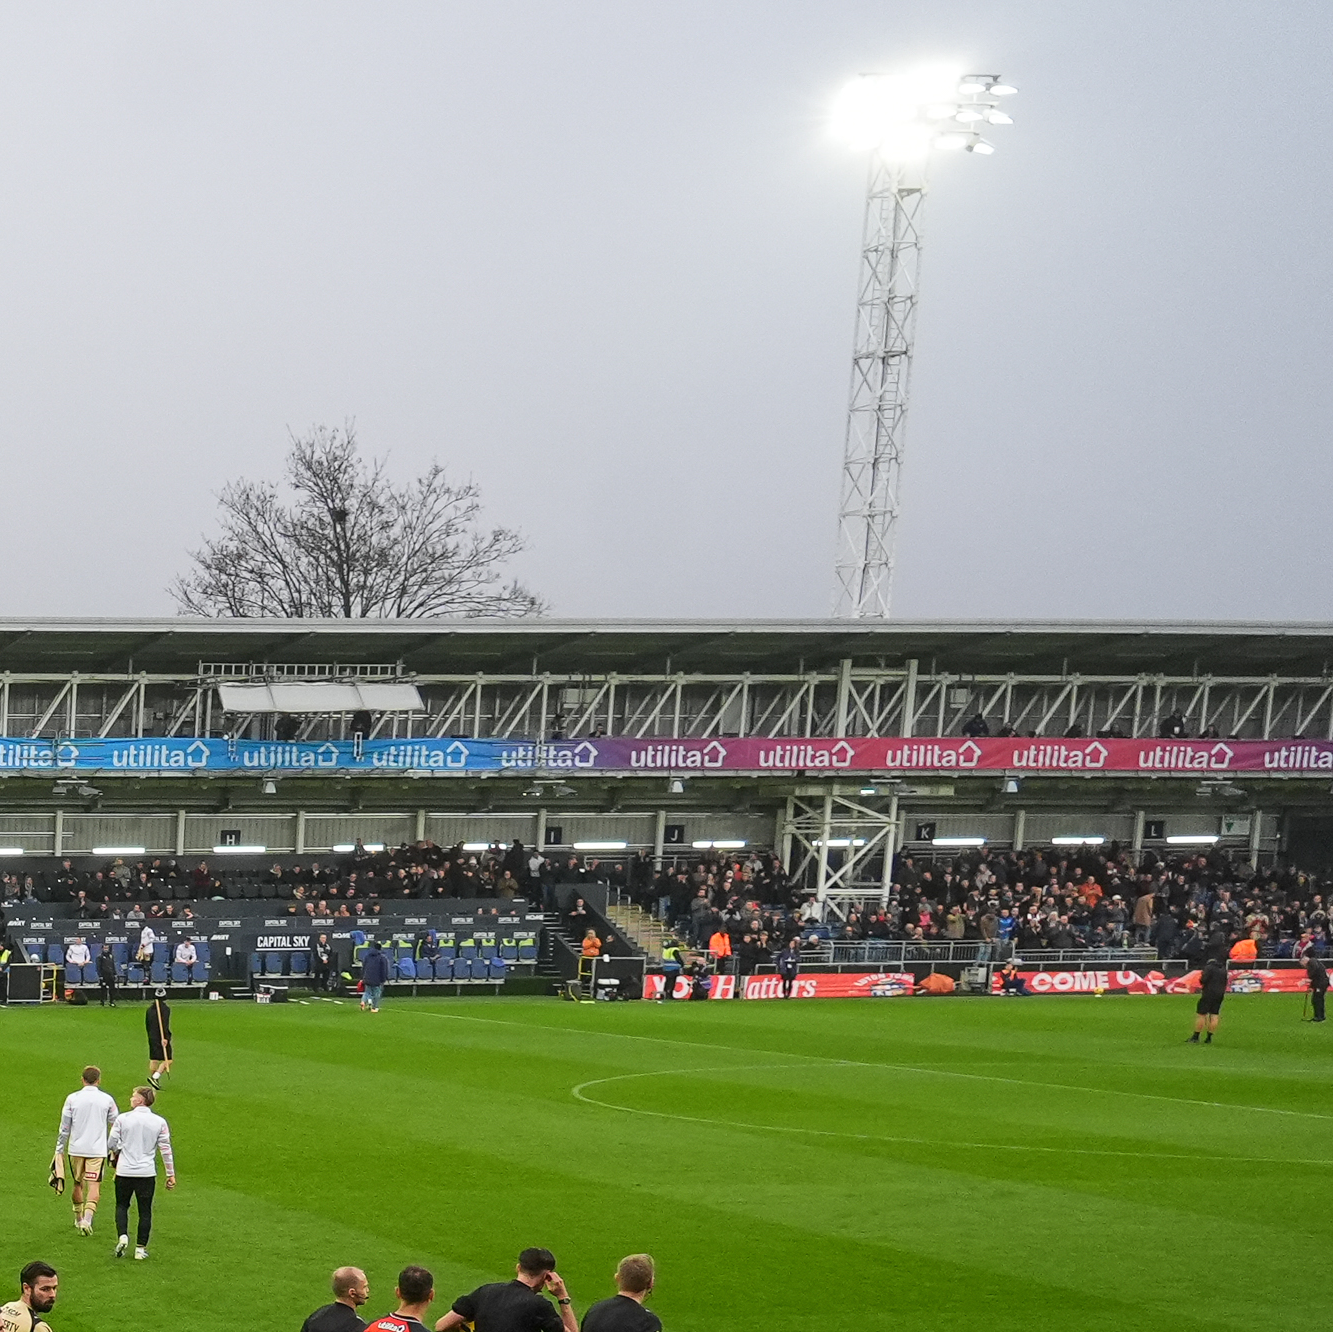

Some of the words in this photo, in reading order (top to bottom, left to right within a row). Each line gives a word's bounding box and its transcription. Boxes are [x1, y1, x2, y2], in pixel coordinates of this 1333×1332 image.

[112, 745, 185, 767] utilita
[242, 744, 317, 767] utilita
[373, 745, 447, 767] utilita
[631, 745, 704, 767] utilita
[758, 745, 830, 767] utilita
[886, 745, 958, 767] utilita
[1012, 745, 1084, 768] utilita
[1138, 745, 1210, 768] utilita
[226, 834, 236, 845] H
[670, 830, 678, 841] J
[922, 828, 930, 839] K
[257, 936, 293, 948] CAPITAL
[294, 936, 310, 947] SKY
[1033, 972, 1110, 992] COME
